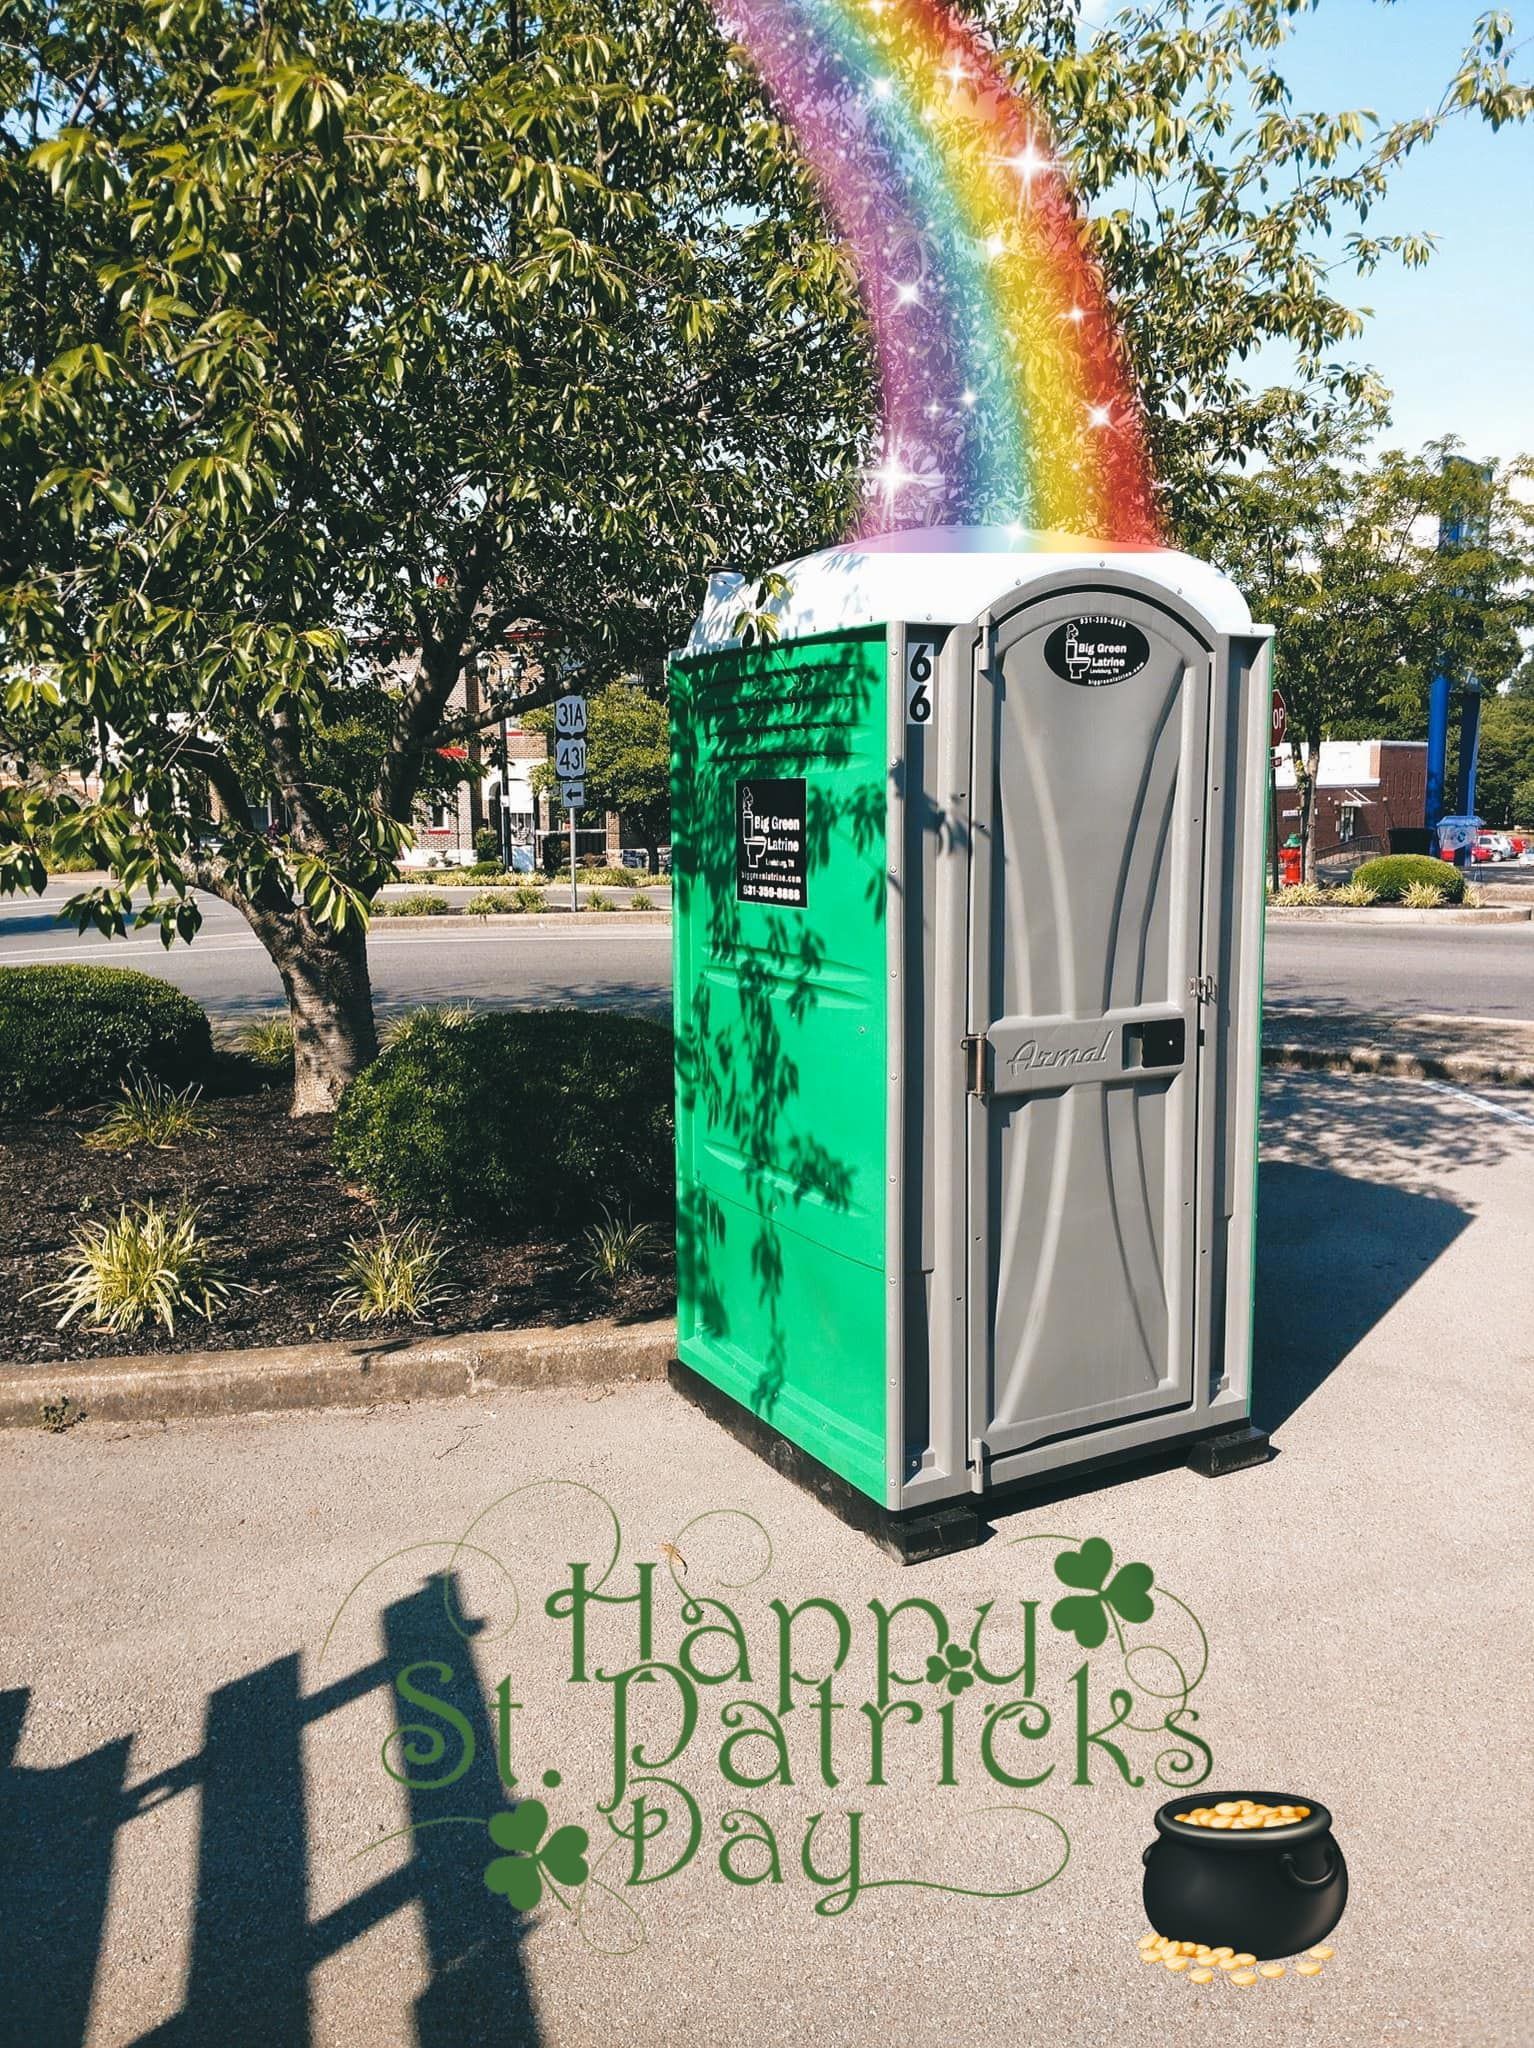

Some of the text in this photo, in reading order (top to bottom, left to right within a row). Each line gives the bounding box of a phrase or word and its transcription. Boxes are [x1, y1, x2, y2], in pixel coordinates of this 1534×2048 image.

[1078, 643, 1127, 655] Big Green
[1092, 657, 1125, 667] Latrine
[558, 702, 584, 727] 31A
[1272, 707, 1284, 730] OP
[559, 747, 584, 771] 431
[754, 815, 800, 833] Big Green
[767, 837, 799, 853] Latrine
[1006, 1031, 1114, 1077] Armal
